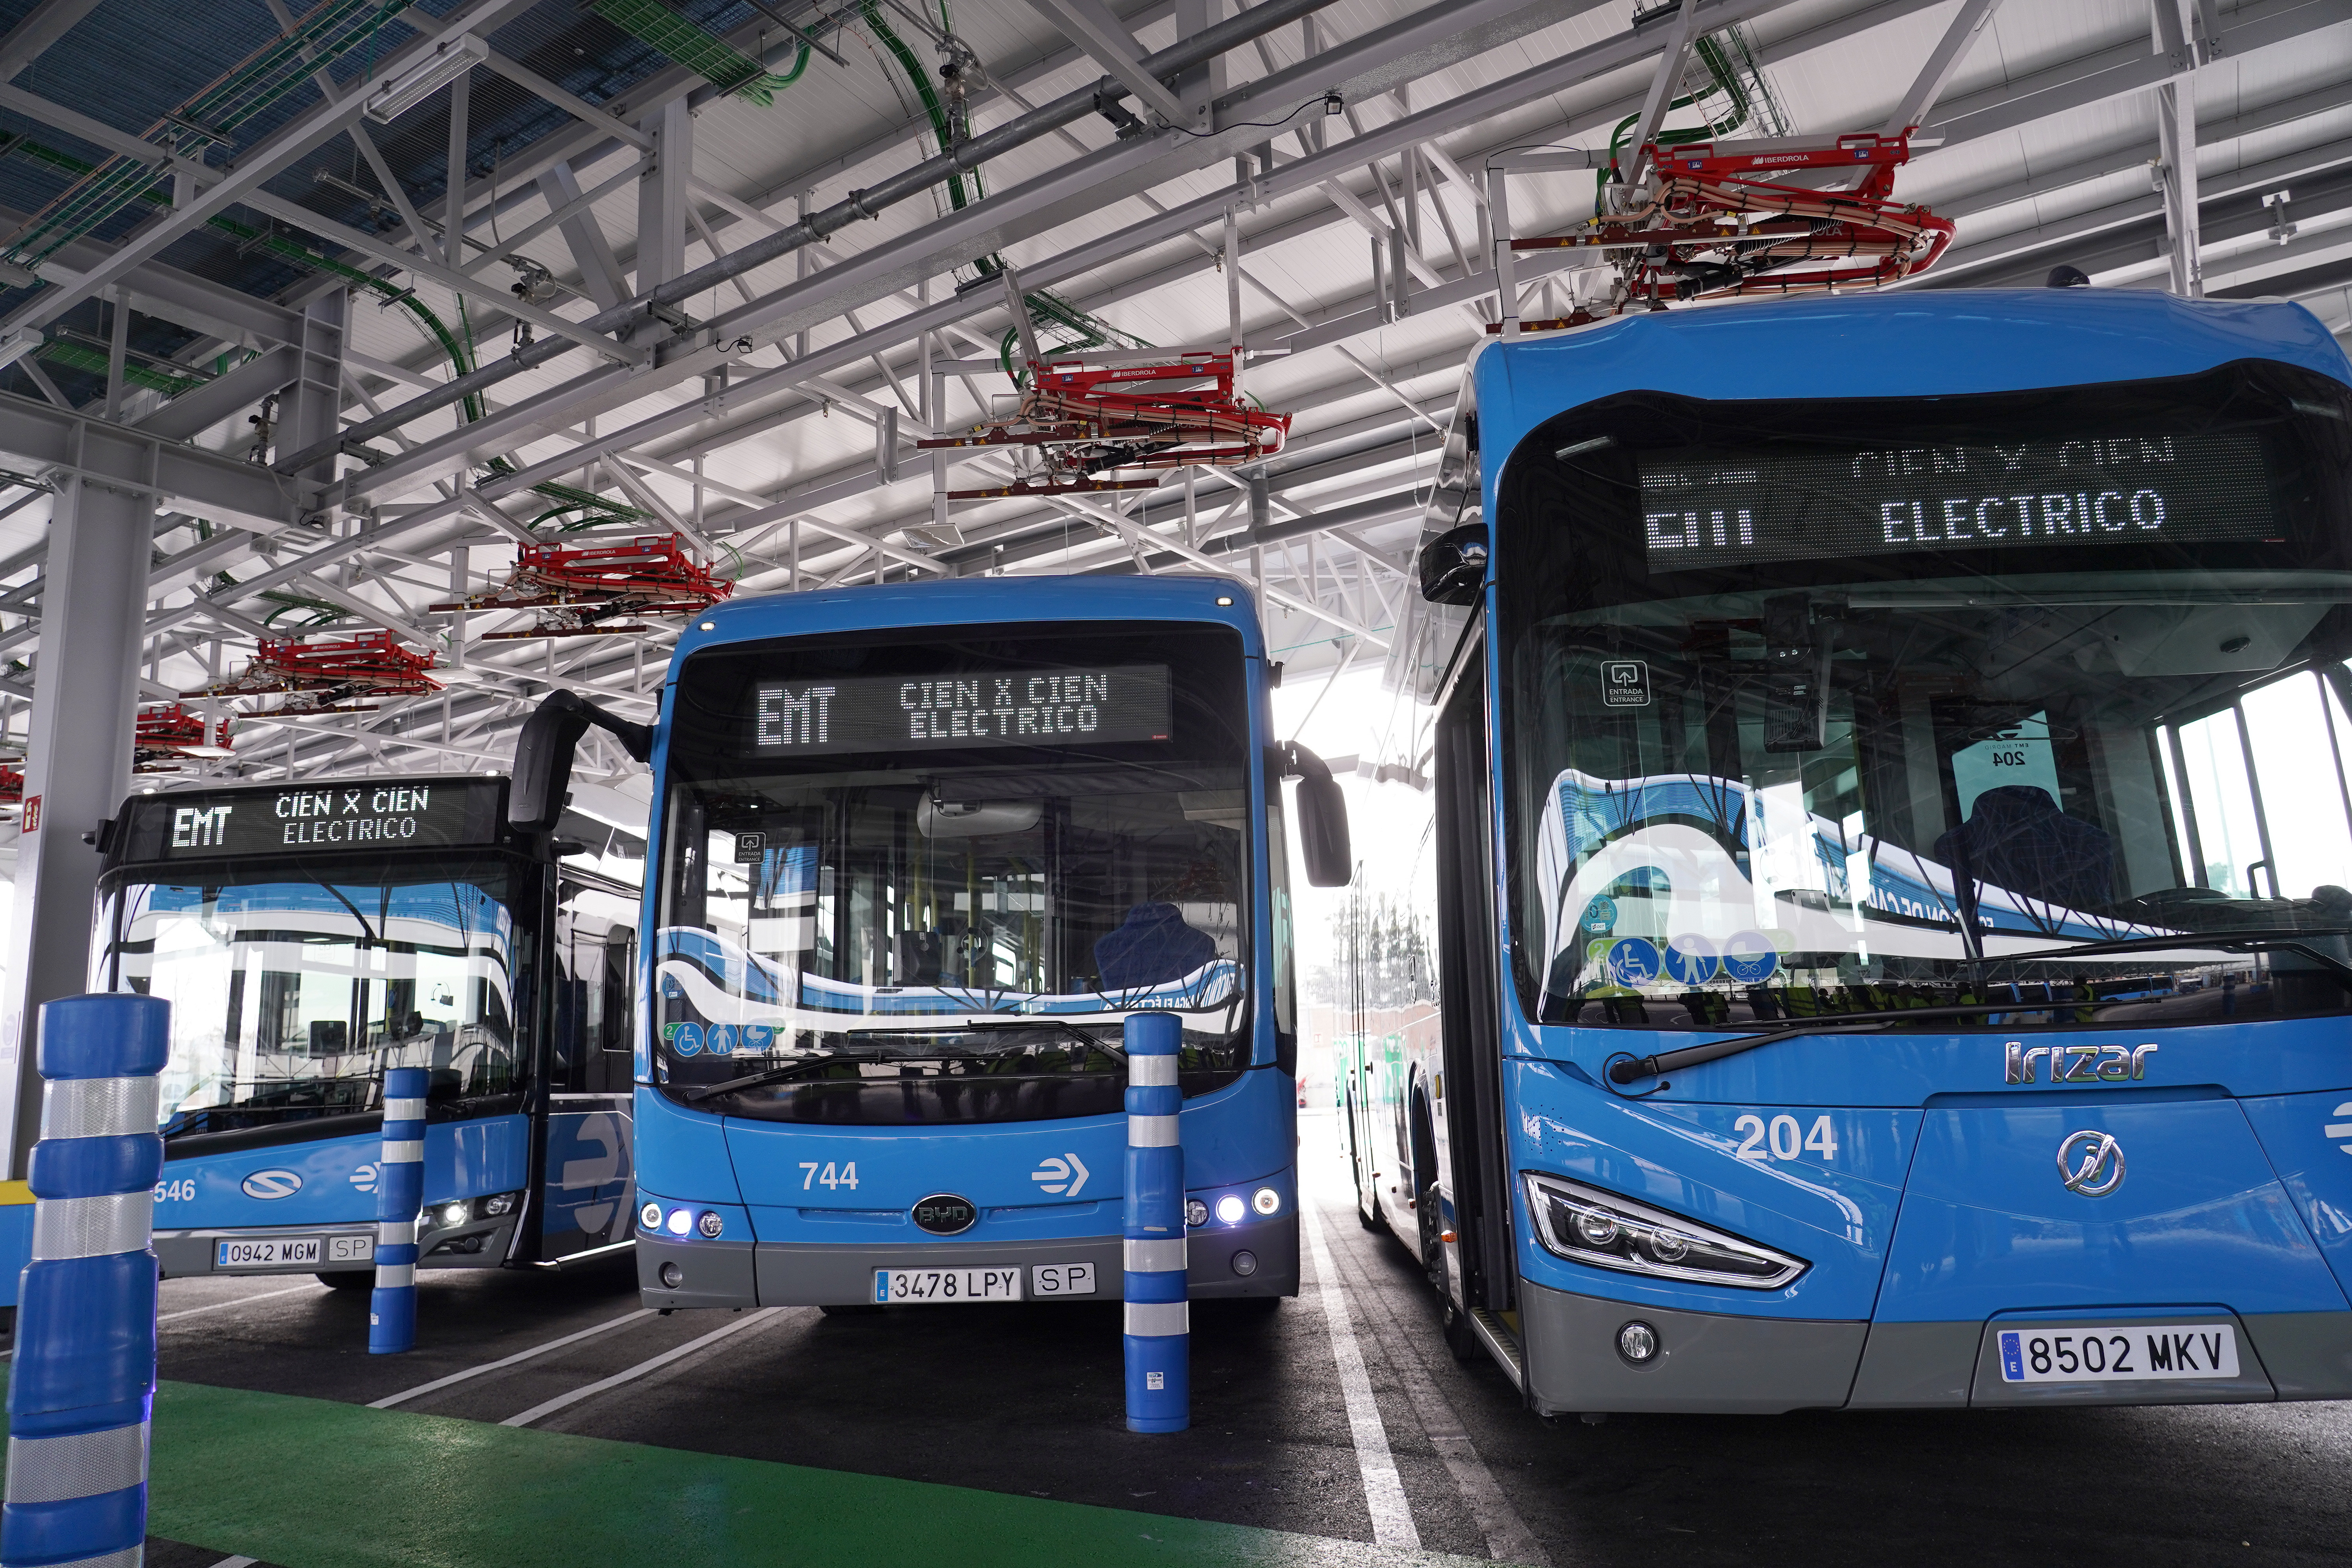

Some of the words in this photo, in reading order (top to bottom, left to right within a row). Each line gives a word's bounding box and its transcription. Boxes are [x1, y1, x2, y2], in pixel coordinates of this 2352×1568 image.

[1764, 154, 1809, 163] IBERDROLA
[1881, 489, 2165, 543] ELECTRICO
[901, 681, 978, 709] CIEN
[995, 679, 1012, 706] X
[1029, 675, 1107, 704] CIEN
[758, 687, 836, 745] EMT
[910, 705, 1098, 739] ELECTRICO
[276, 793, 332, 818] CIEN
[343, 793, 361, 814] X
[372, 788, 428, 813] CIEN
[172, 806, 232, 847] EMT
[283, 817, 416, 844] ELECTRICO
[666, 1025, 673, 1035] 2
[2005, 1041, 2158, 1084] Irizar
[1734, 1114, 1838, 1160] 204
[799, 1161, 859, 1190] 744
[154, 1179, 196, 1203] 546
[918, 1206, 968, 1223] BYD
[232, 1245, 274, 1261] 0942
[282, 1243, 317, 1260] MGM
[895, 1273, 957, 1298] 3478
[968, 1272, 1014, 1297] LPY
[2010, 1361, 2018, 1372] E
[2029, 1336, 2134, 1374] 8502
[2147, 1333, 2221, 1371] MKV
